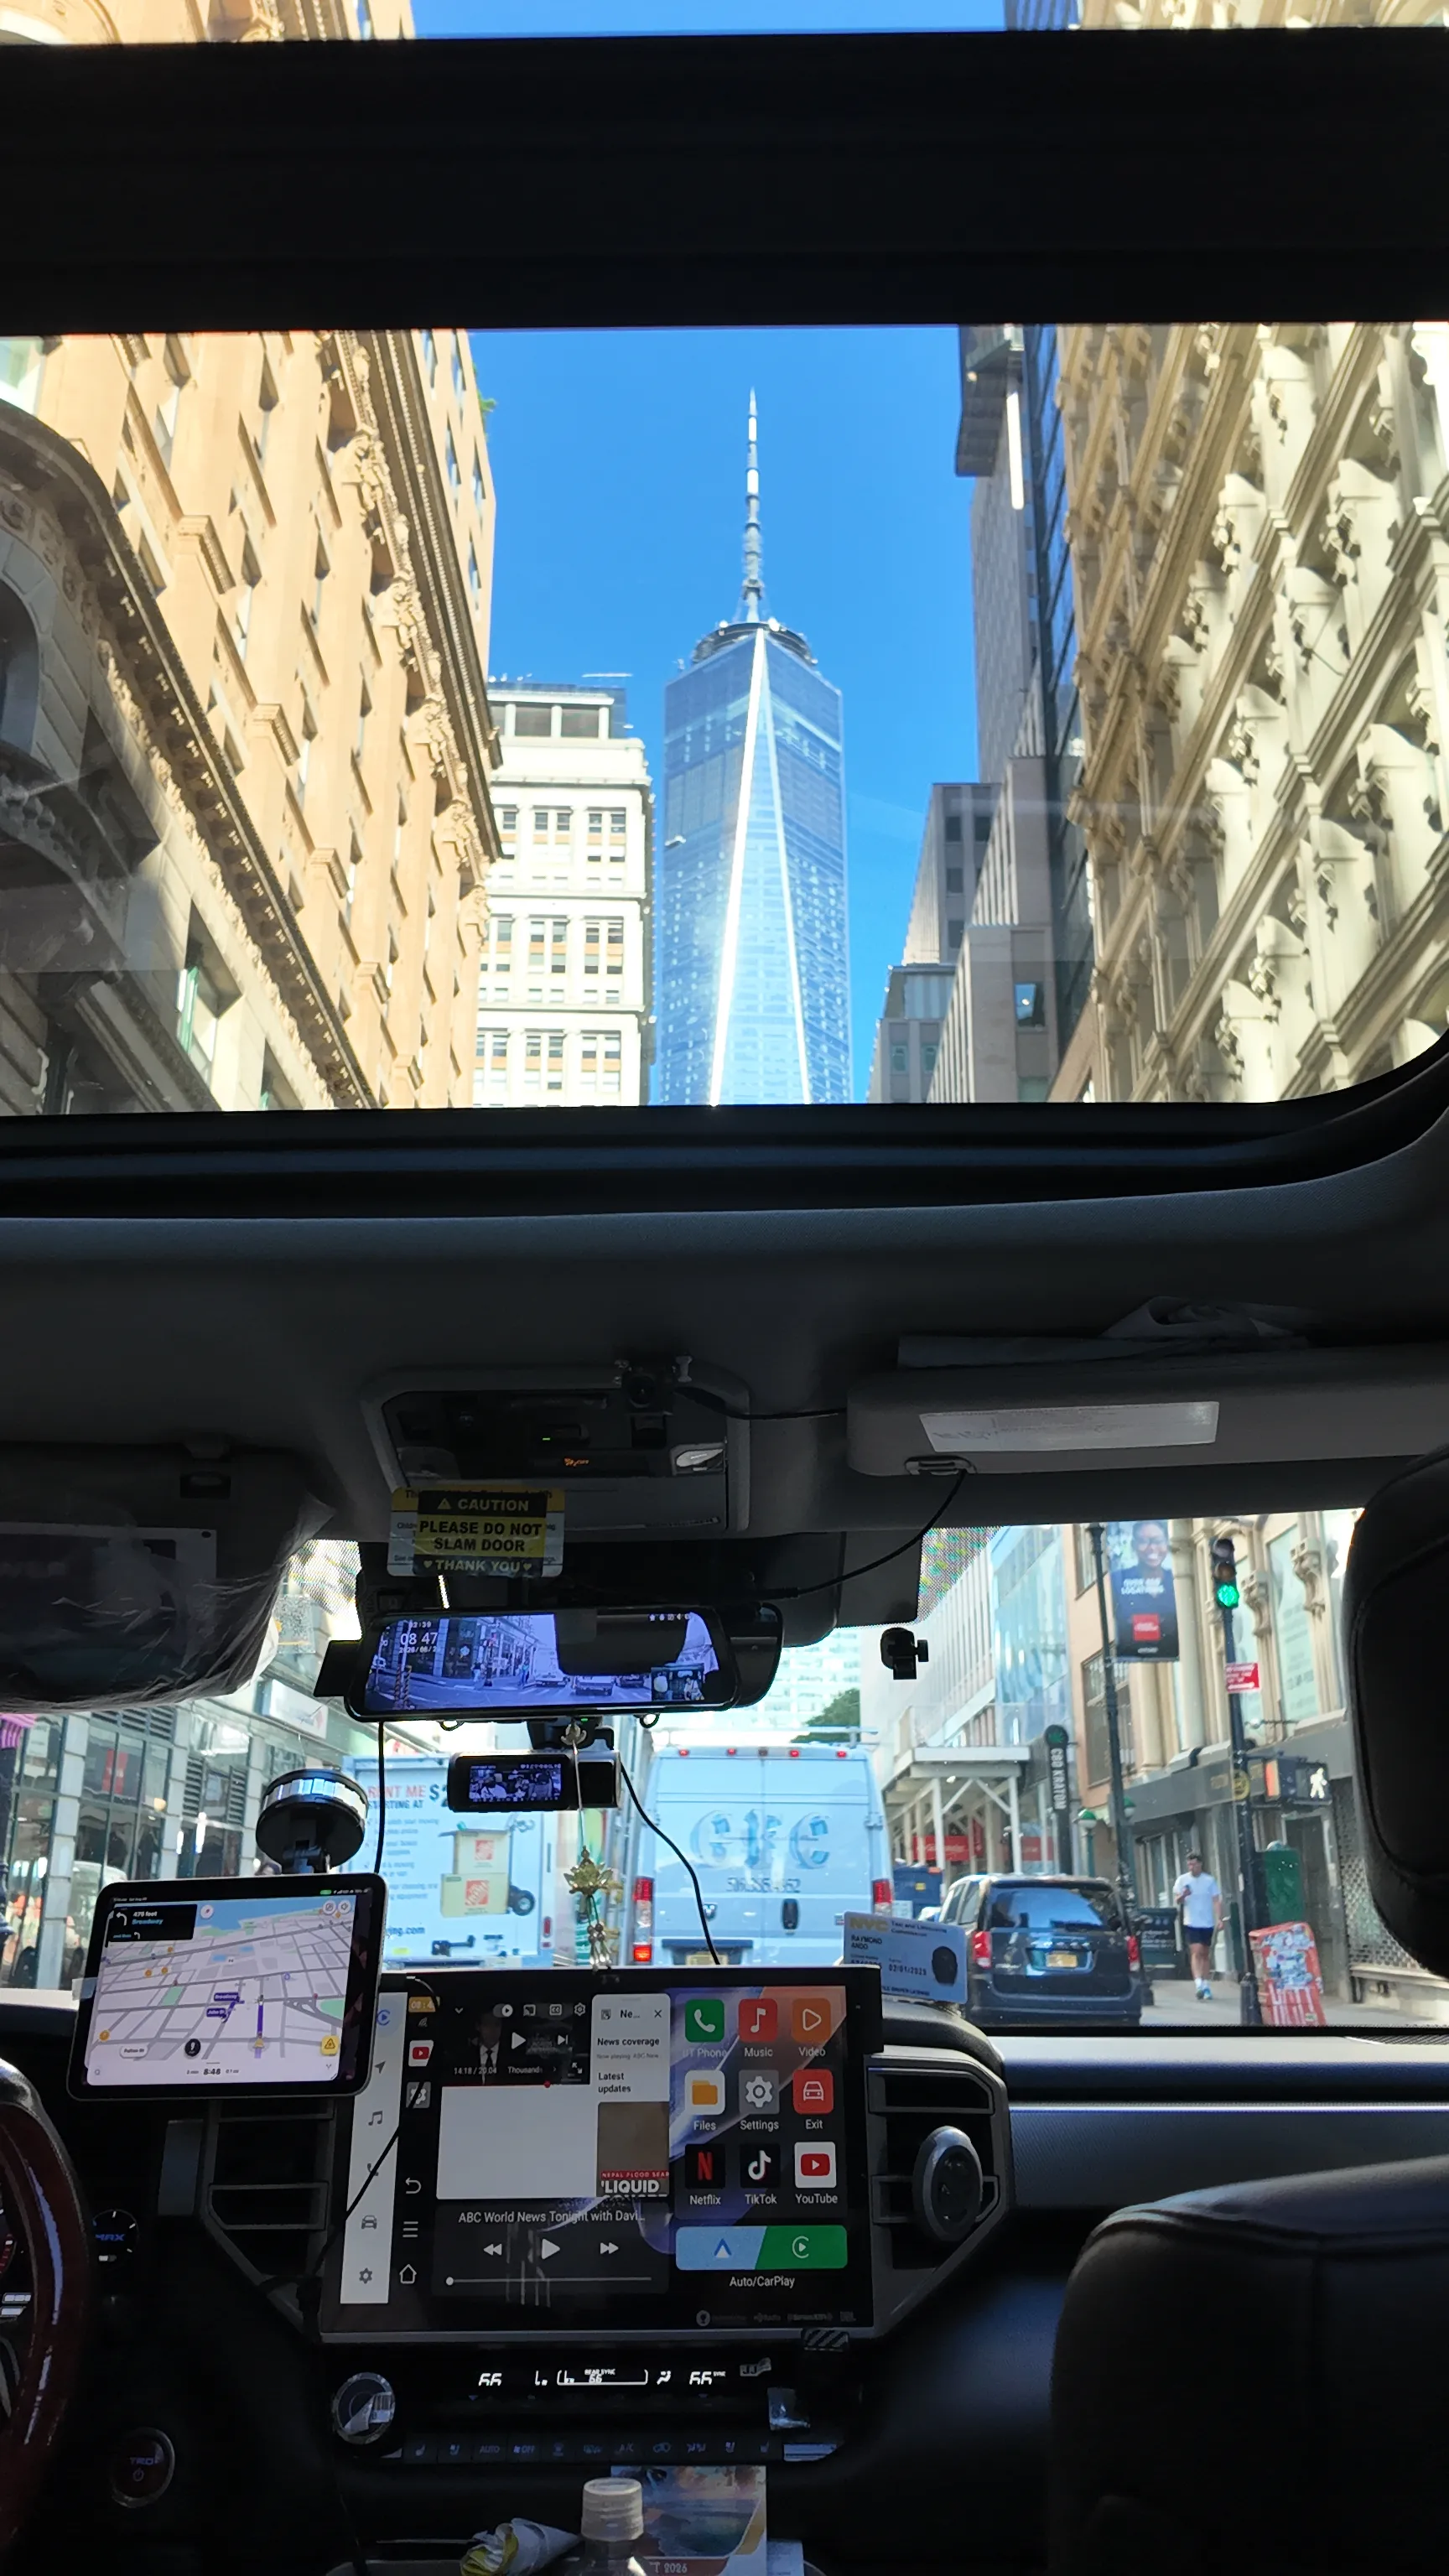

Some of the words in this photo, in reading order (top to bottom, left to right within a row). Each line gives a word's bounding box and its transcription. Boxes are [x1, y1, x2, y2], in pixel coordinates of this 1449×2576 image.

[458, 1498, 529, 1512] CAUTION
[419, 1520, 479, 1535] PLEASE
[483, 1522, 505, 1535] DO
[510, 1523, 543, 1536] NOT
[434, 1537, 476, 1550] SLAM
[481, 1539, 525, 1552] DOOR
[434, 1559, 486, 1571] THANK
[491, 1561, 521, 1573] YOU
[1051, 1748, 1064, 1768] CBD
[368, 1785, 402, 1799] RNT
[406, 1784, 426, 1798] ME
[1052, 1769, 1067, 1810] KRATOM
[413, 1800, 423, 1809] AT
[849, 1918, 888, 1932] NYC
[410, 2000, 434, 2010] 08:4
[597, 2038, 620, 2046] News
[621, 2038, 660, 2048] coverage
[698, 2048, 728, 2058] Phone
[744, 2047, 773, 2057] Music
[798, 2046, 826, 2057] Video
[598, 2072, 625, 2080] Latest
[598, 2085, 631, 2094] updates
[693, 2121, 717, 2131] Files
[740, 2120, 780, 2132] Settings
[805, 2119, 823, 2130] Exit
[689, 2194, 721, 2205] Netflix
[745, 2194, 778, 2205] TikTok
[795, 2193, 839, 2205] YouTube
[459, 2211, 482, 2223] ABC
[484, 2211, 515, 2223] World
[517, 2211, 546, 2222] News
[548, 2210, 589, 2225] Tonight
[589, 2210, 613, 2221] with
[729, 2275, 796, 2290] Auto/CarPlay
[478, 2372, 502, 2386] 66
[689, 2371, 713, 2385] 66
[480, 2444, 501, 2454] AUTO
[663, 2561, 688, 2573] 2026
